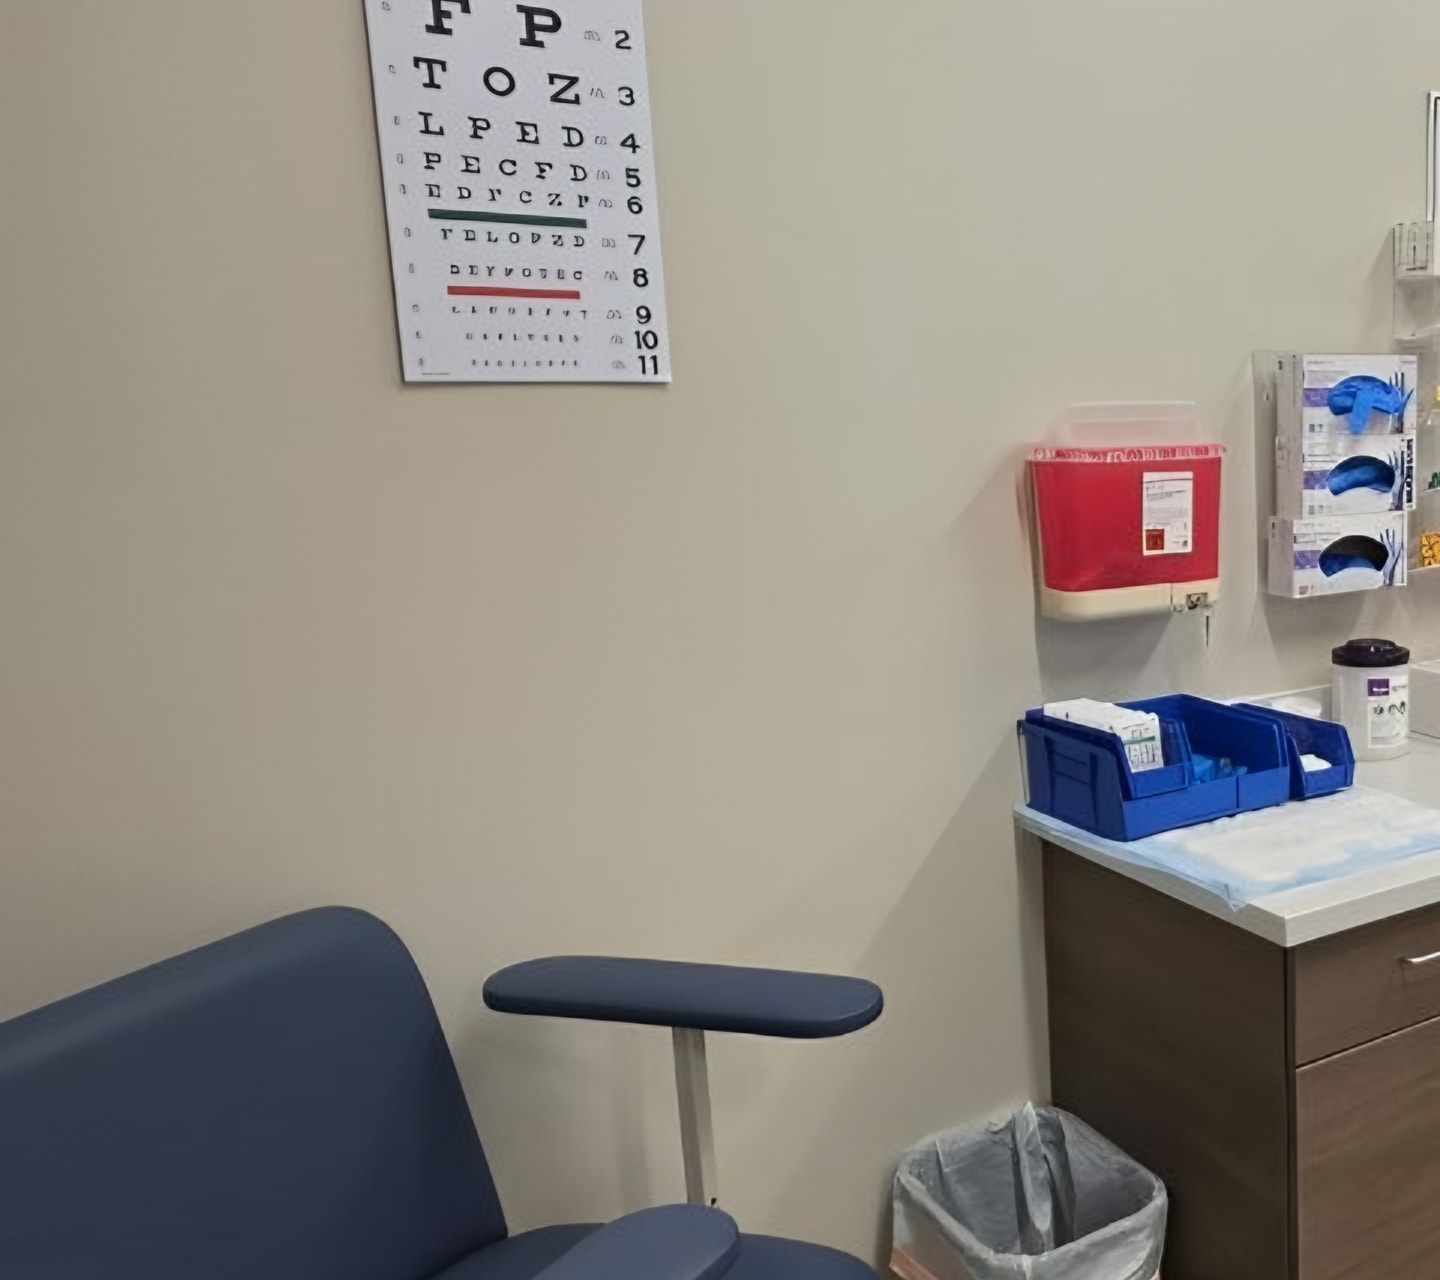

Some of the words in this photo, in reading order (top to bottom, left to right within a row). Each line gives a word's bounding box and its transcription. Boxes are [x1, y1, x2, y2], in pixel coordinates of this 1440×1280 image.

[516, 4, 562, 49] P
[615, 30, 632, 50] 2
[413, 56, 447, 89] T
[483, 66, 516, 97] O
[547, 73, 581, 106] Z
[618, 86, 635, 107] 3
[418, 111, 445, 136] L
[467, 116, 491, 140] P
[515, 121, 540, 145] E
[561, 126, 584, 148] D
[620, 133, 641, 154] 4
[423, 152, 441, 170] P
[460, 155, 481, 174] E
[499, 159, 517, 176] C
[569, 164, 588, 182] D
[625, 167, 641, 188] 5
[519, 191, 533, 204] C
[627, 196, 643, 215] 6
[627, 234, 645, 255] 7
[633, 268, 649, 288] 8
[636, 305, 652, 325] 9
[634, 330, 658, 350] 10
[638, 355, 658, 375] 11
